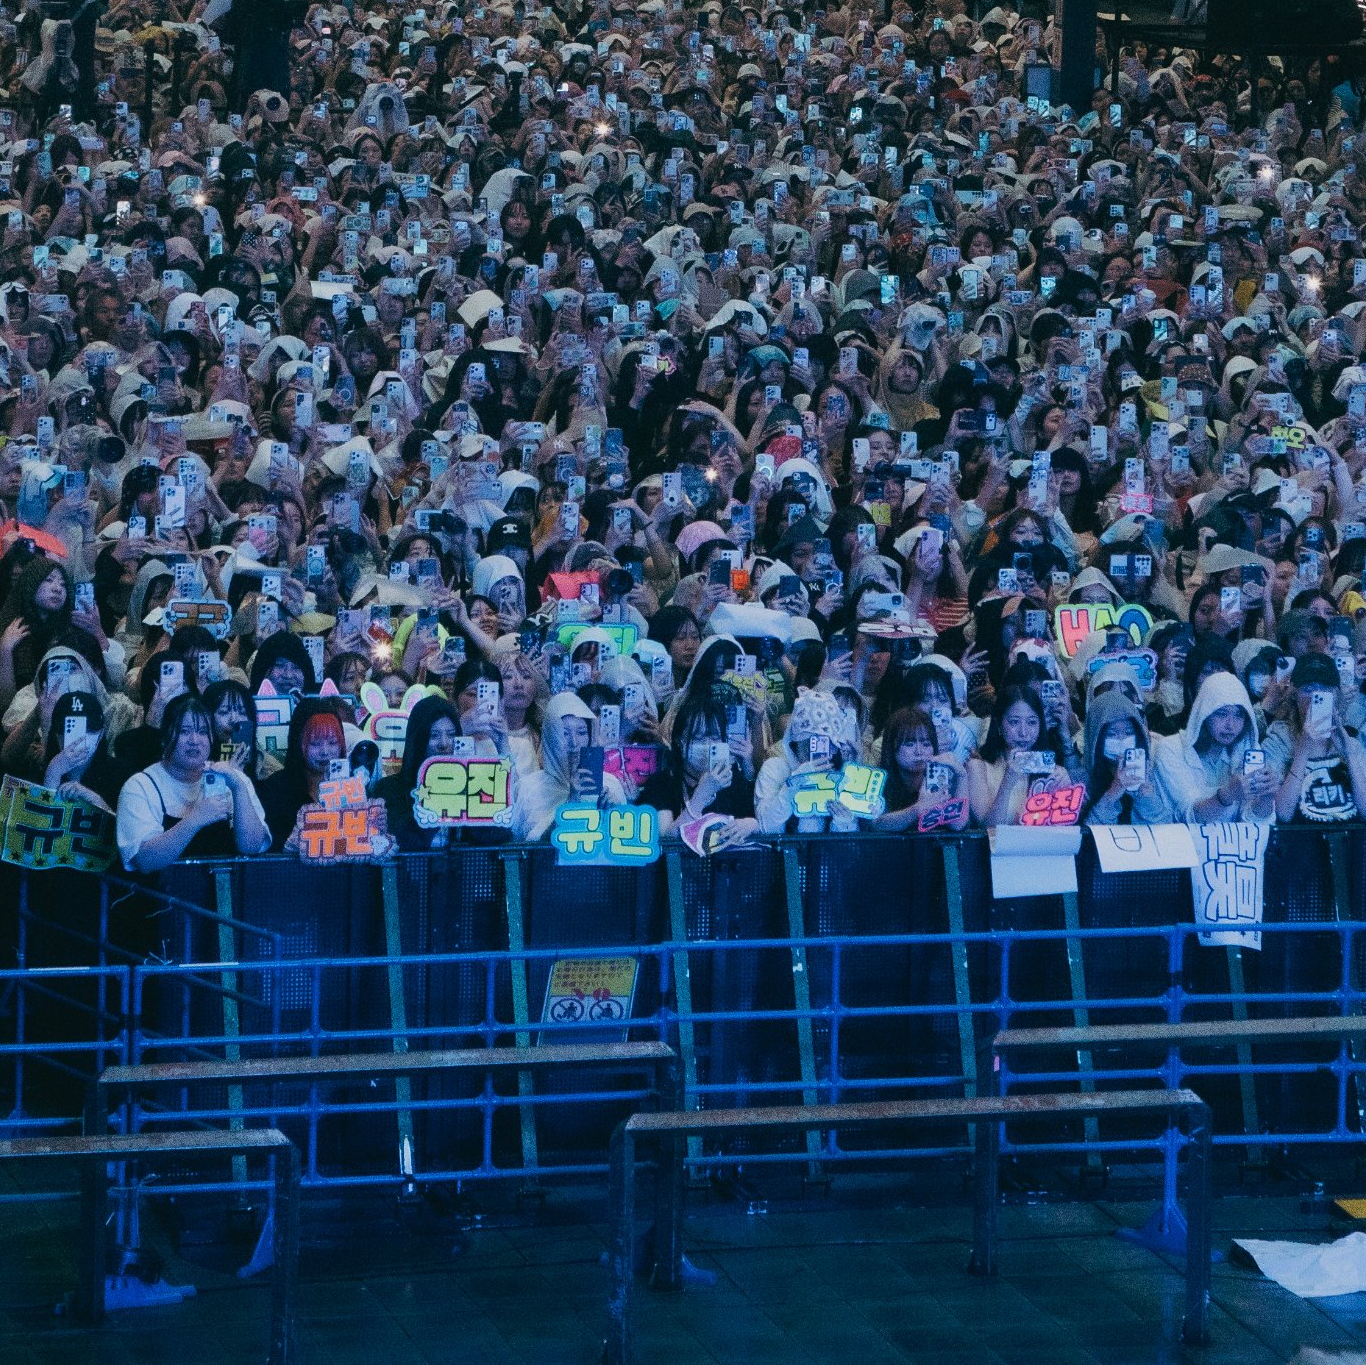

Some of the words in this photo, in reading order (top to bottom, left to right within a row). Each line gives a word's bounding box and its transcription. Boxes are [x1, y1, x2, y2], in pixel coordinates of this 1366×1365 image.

[71, 696, 83, 712] LA
[423, 762, 508, 818] 유진
[1020, 786, 1084, 826] 유진
[557, 808, 653, 856] 규빈
